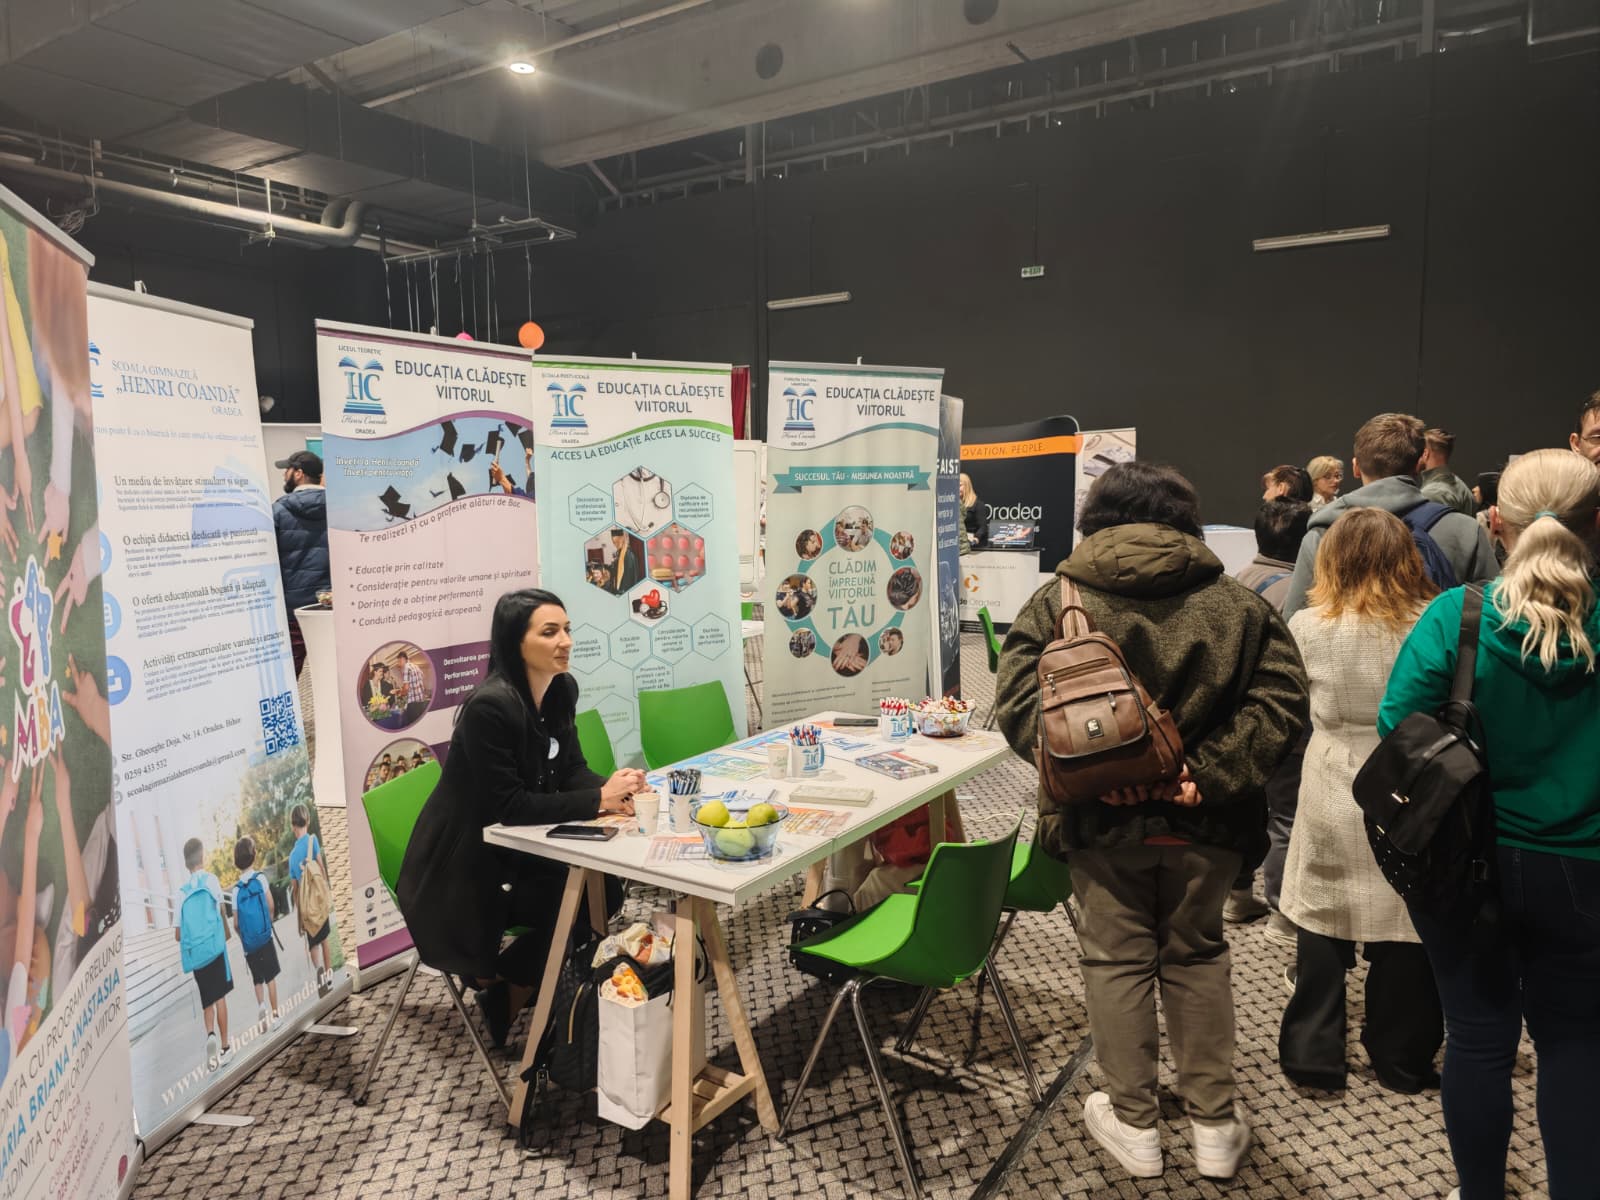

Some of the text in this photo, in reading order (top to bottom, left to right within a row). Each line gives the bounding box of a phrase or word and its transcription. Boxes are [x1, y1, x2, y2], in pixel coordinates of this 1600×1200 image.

[395, 360, 527, 389] EDUCAȚIA CLĂDEȘTE
[436, 385, 495, 404] VIITORUL
[598, 382, 725, 400] EDUCAȚIA CLĂDEȘTE
[826, 387, 935, 404] EDUCAȚIA CLĂDEȘTE
[635, 400, 692, 414] VIITORUL
[857, 404, 906, 417] VIITORUL
[550, 427, 721, 461] ACCES LA EDUCAȚIE ACCES LA SUCCES
[114, 476, 126, 486] Un
[152, 476, 162, 486] de
[794, 470, 914, 481] SUCCESUL TĂU MISIUNEA NOASTRĂ
[360, 534, 370, 544] Te
[372, 526, 408, 542] realizezi
[410, 522, 417, 534] și
[419, 518, 429, 528] cu
[438, 503, 468, 522] profesie
[469, 498, 496, 510] alături
[497, 498, 506, 506] de
[508, 499, 521, 508] Bac
[122, 535, 130, 546] O
[356, 560, 444, 576] Educație prin calitate
[829, 558, 877, 575] CLĂDIM
[356, 580, 409, 592] Considerație
[411, 578, 438, 589] pentru
[440, 574, 466, 585] valorile
[468, 573, 492, 582] umane
[494, 570, 500, 580] și
[829, 574, 876, 586] ÎMPREUNĂ
[358, 598, 390, 610] Dorința
[392, 596, 402, 606] de
[410, 593, 437, 606] obține
[438, 588, 484, 602] performanță
[829, 586, 876, 599] VIITORUL
[132, 596, 140, 607] O
[359, 604, 482, 628] Conduită pedagogică europeană
[827, 598, 876, 630] TĂU
[444, 654, 477, 666] Dezvoltarea
[444, 668, 478, 680] Performanță
[445, 684, 474, 696] Integritate
[121, 752, 132, 762] Str.
[124, 768, 142, 781] 0259
[95, 995, 121, 1038] VIITOR
[29, 1045, 45, 1079] CU
[0, 1113, 26, 1180] ARIA
[29, 1043, 70, 1124] BRIANA
[71, 967, 120, 1055] ANASTASIA
